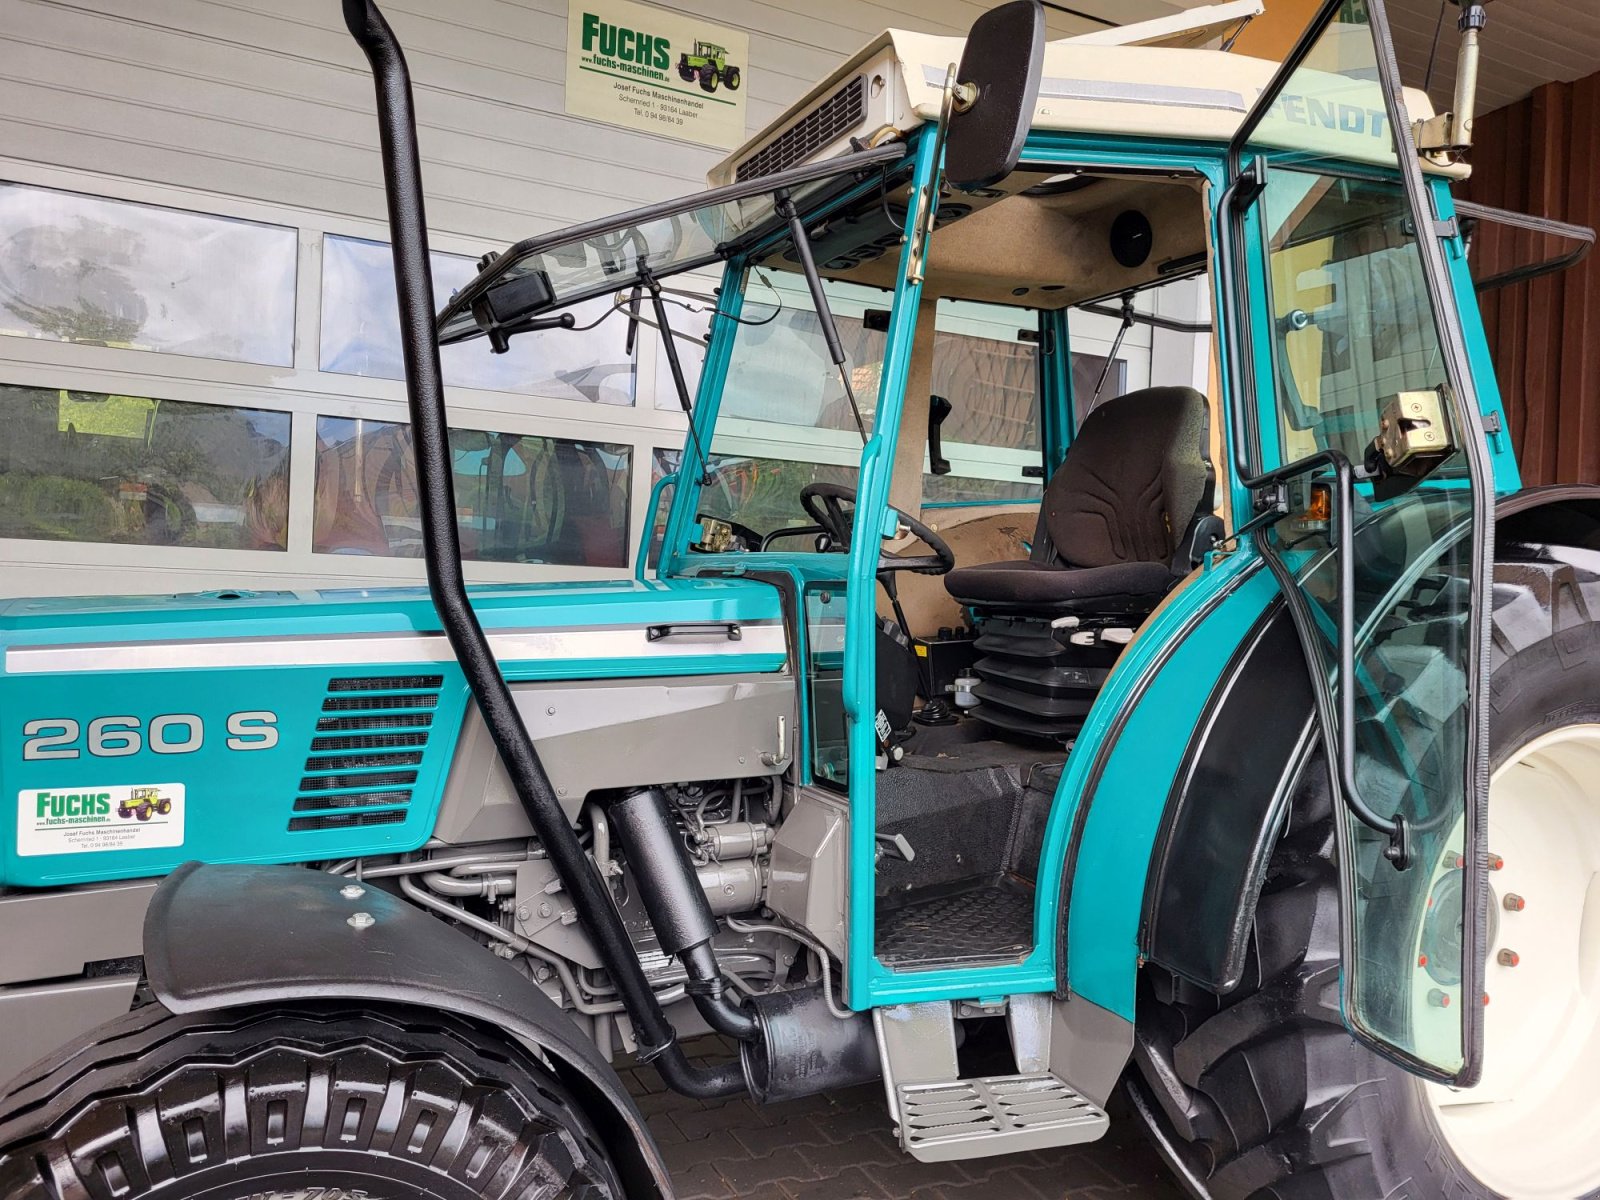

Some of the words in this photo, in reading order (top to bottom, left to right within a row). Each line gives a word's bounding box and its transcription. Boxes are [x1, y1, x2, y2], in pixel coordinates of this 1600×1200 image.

[582, 12, 671, 71] FUCHS
[581, 54, 670, 82] www.fuchs-maschinen.de
[613, 82, 631, 92] Josef
[632, 86, 650, 97] Fuchs
[652, 91, 704, 109] Maschinenhandel
[660, 104, 677, 114] 93164
[23, 713, 205, 762] 260
[225, 710, 280, 751] S
[36, 792, 111, 818] FUCHS
